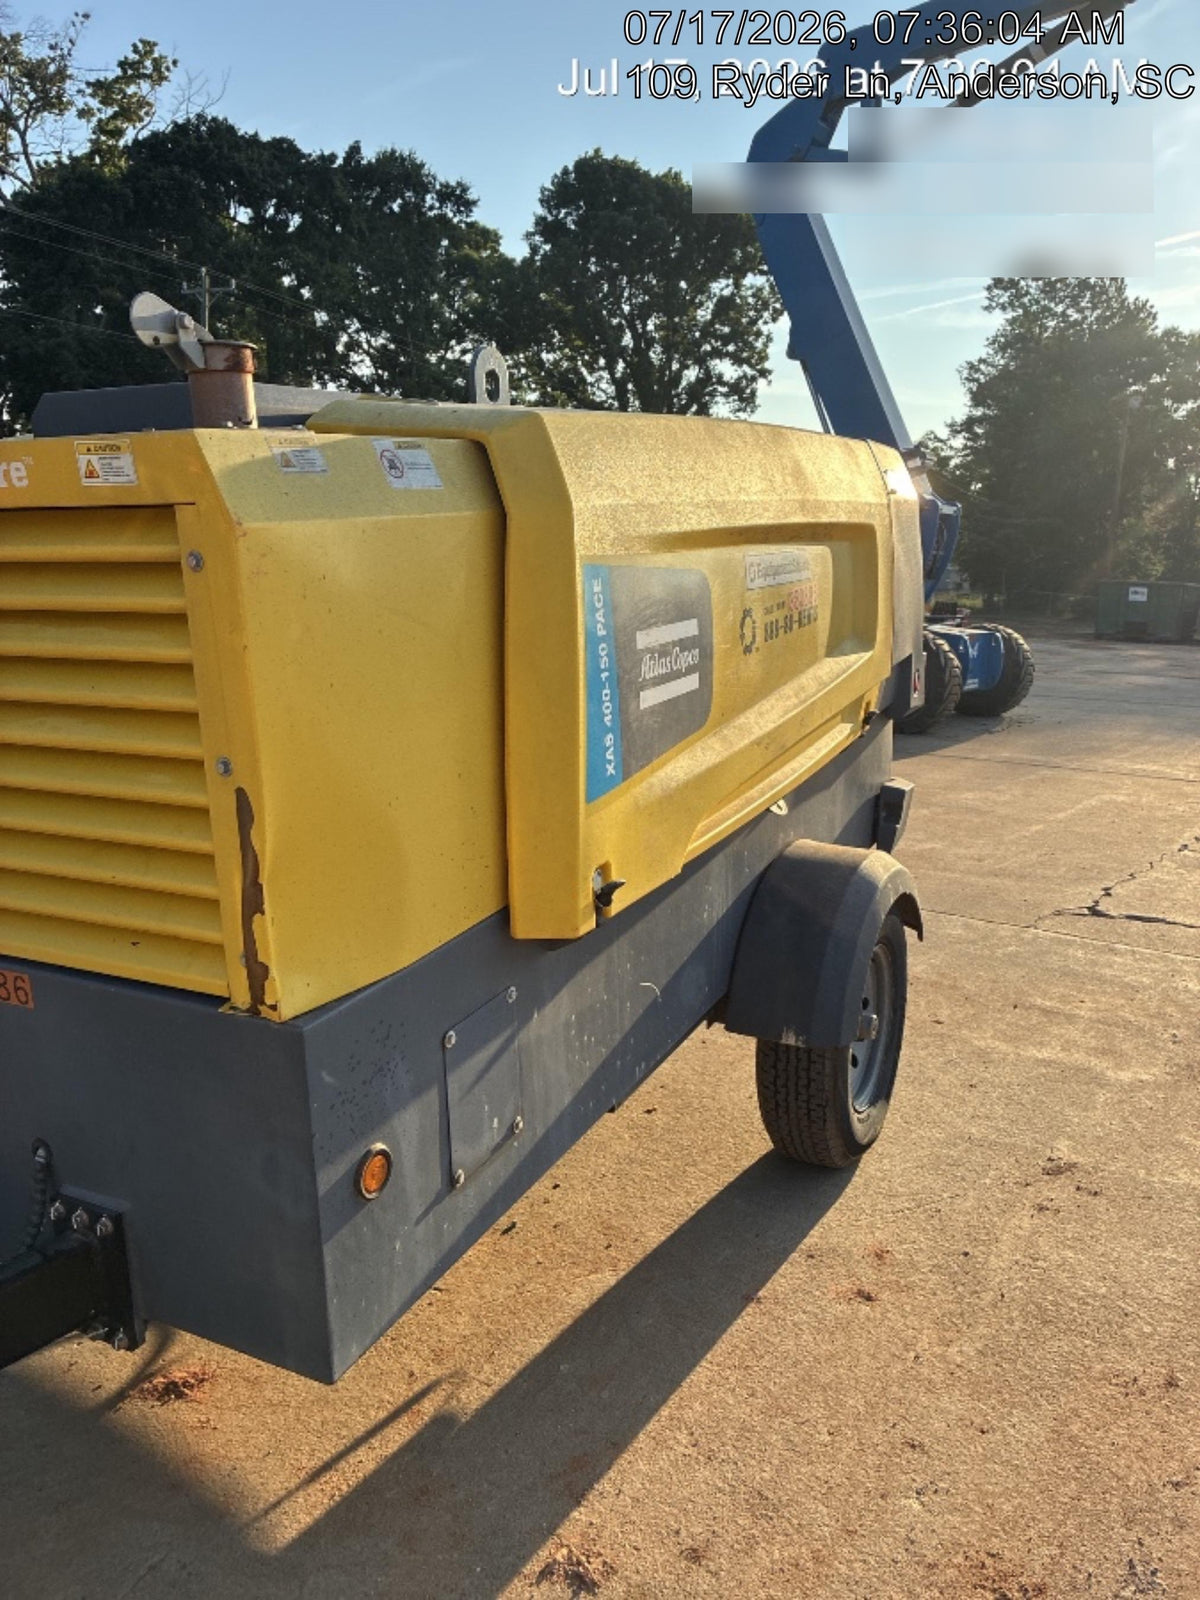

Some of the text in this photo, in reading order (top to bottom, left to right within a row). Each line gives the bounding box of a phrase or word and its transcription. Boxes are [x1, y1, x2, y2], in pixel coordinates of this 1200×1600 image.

[593, 577, 607, 638] PACE
[638, 646, 700, 682] Atlas Copco
